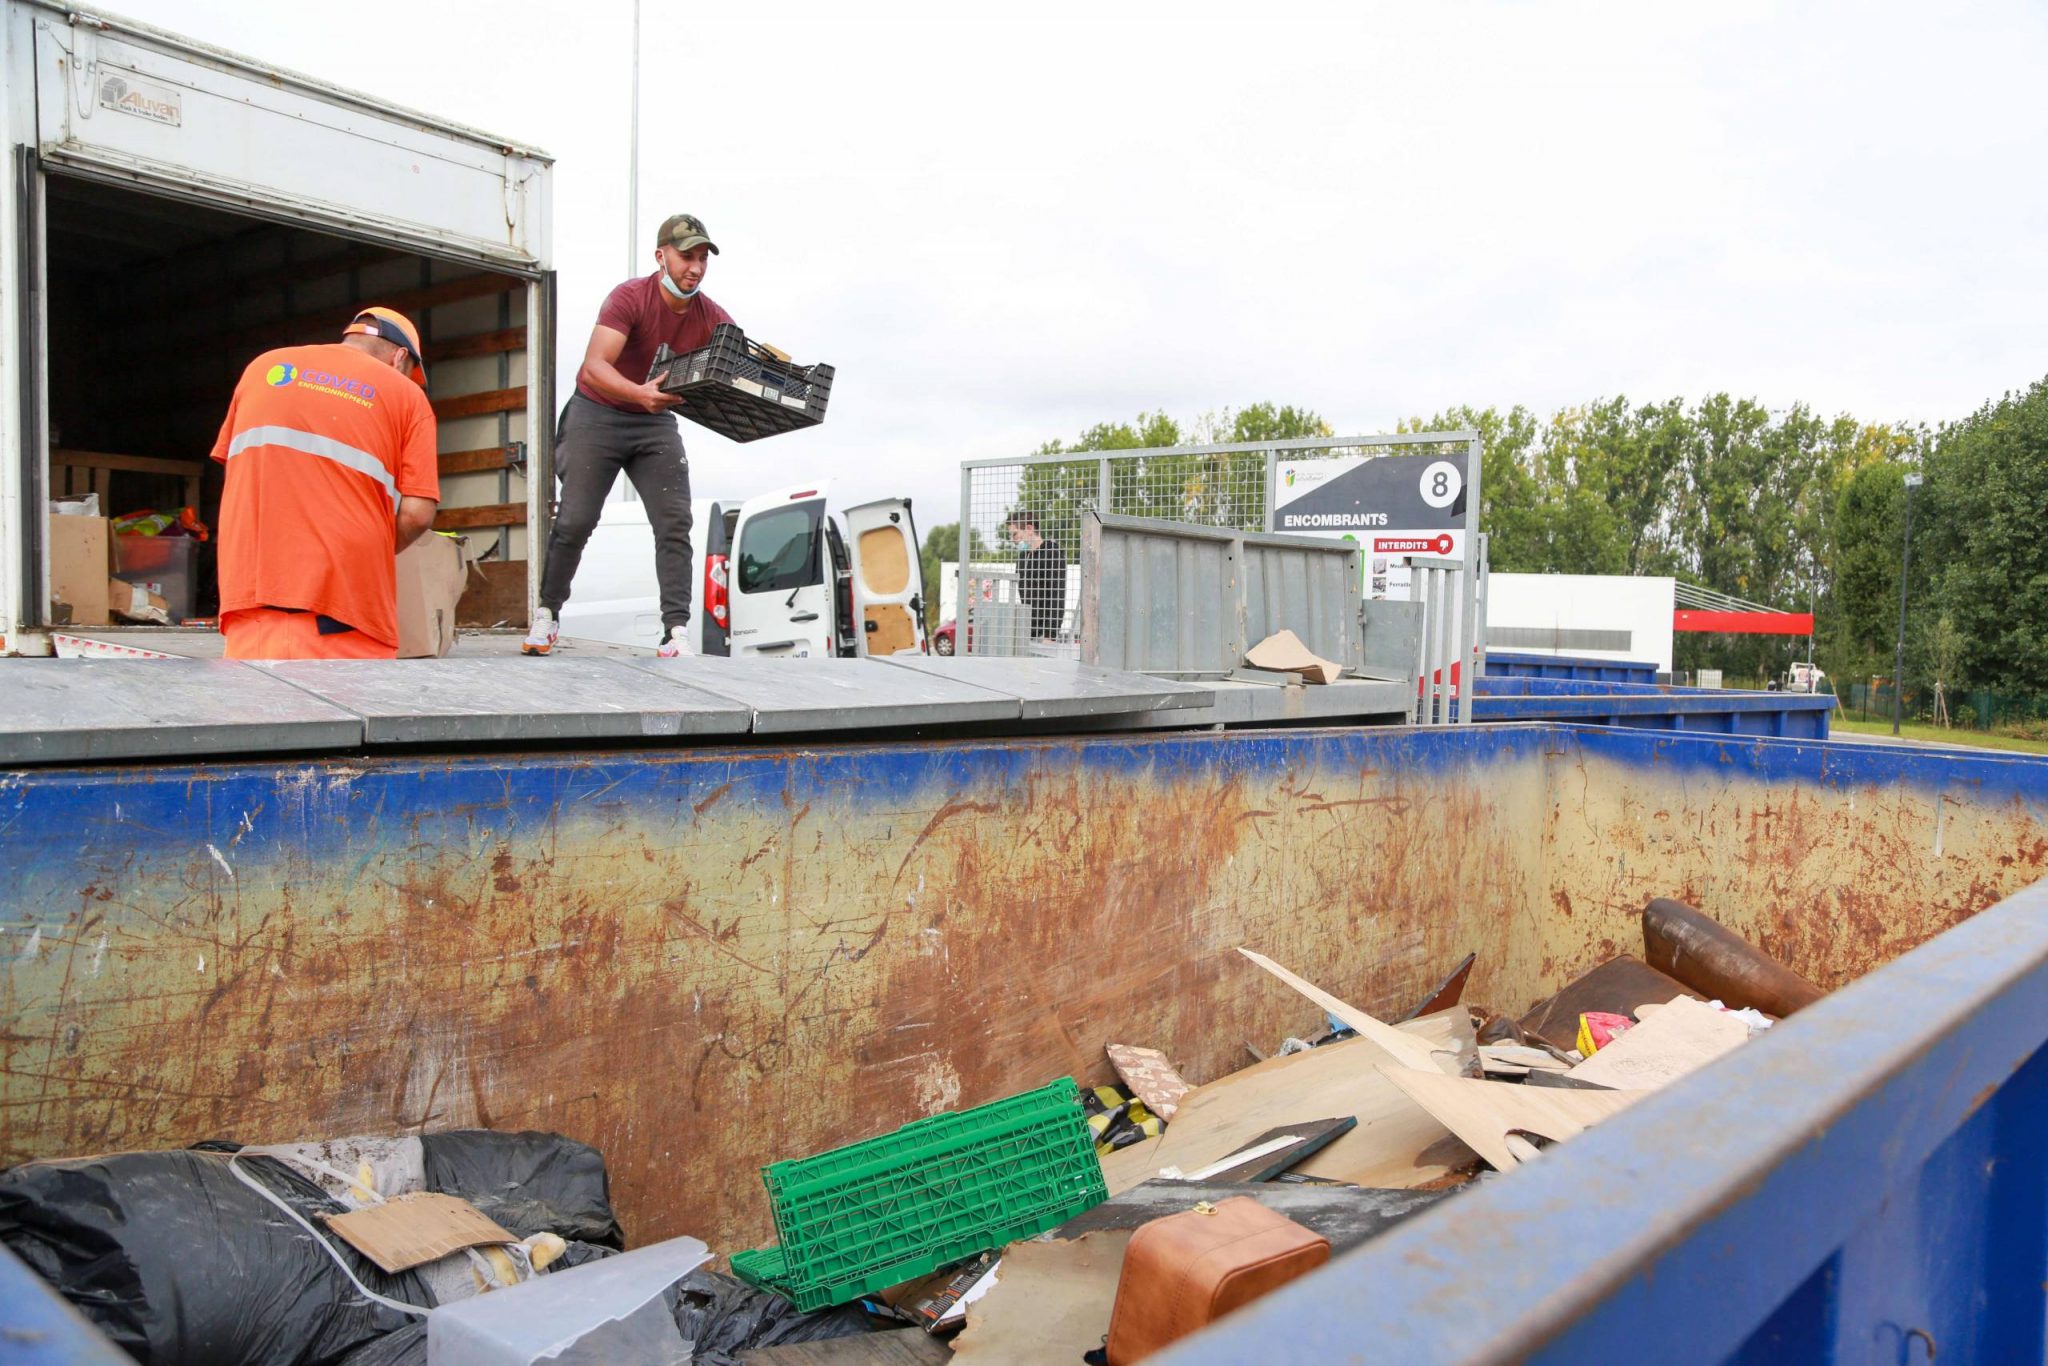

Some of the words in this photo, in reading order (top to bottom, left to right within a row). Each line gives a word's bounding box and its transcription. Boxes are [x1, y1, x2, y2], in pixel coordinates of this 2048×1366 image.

[118, 92, 180, 121] Aluvan
[298, 381, 374, 409] ENVIRONNEMENT
[301, 369, 376, 399] COVED
[1432, 471, 1449, 498] 8
[1284, 513, 1388, 527] ENCOMBRANTS
[1378, 541, 1428, 550] INTERDITS
